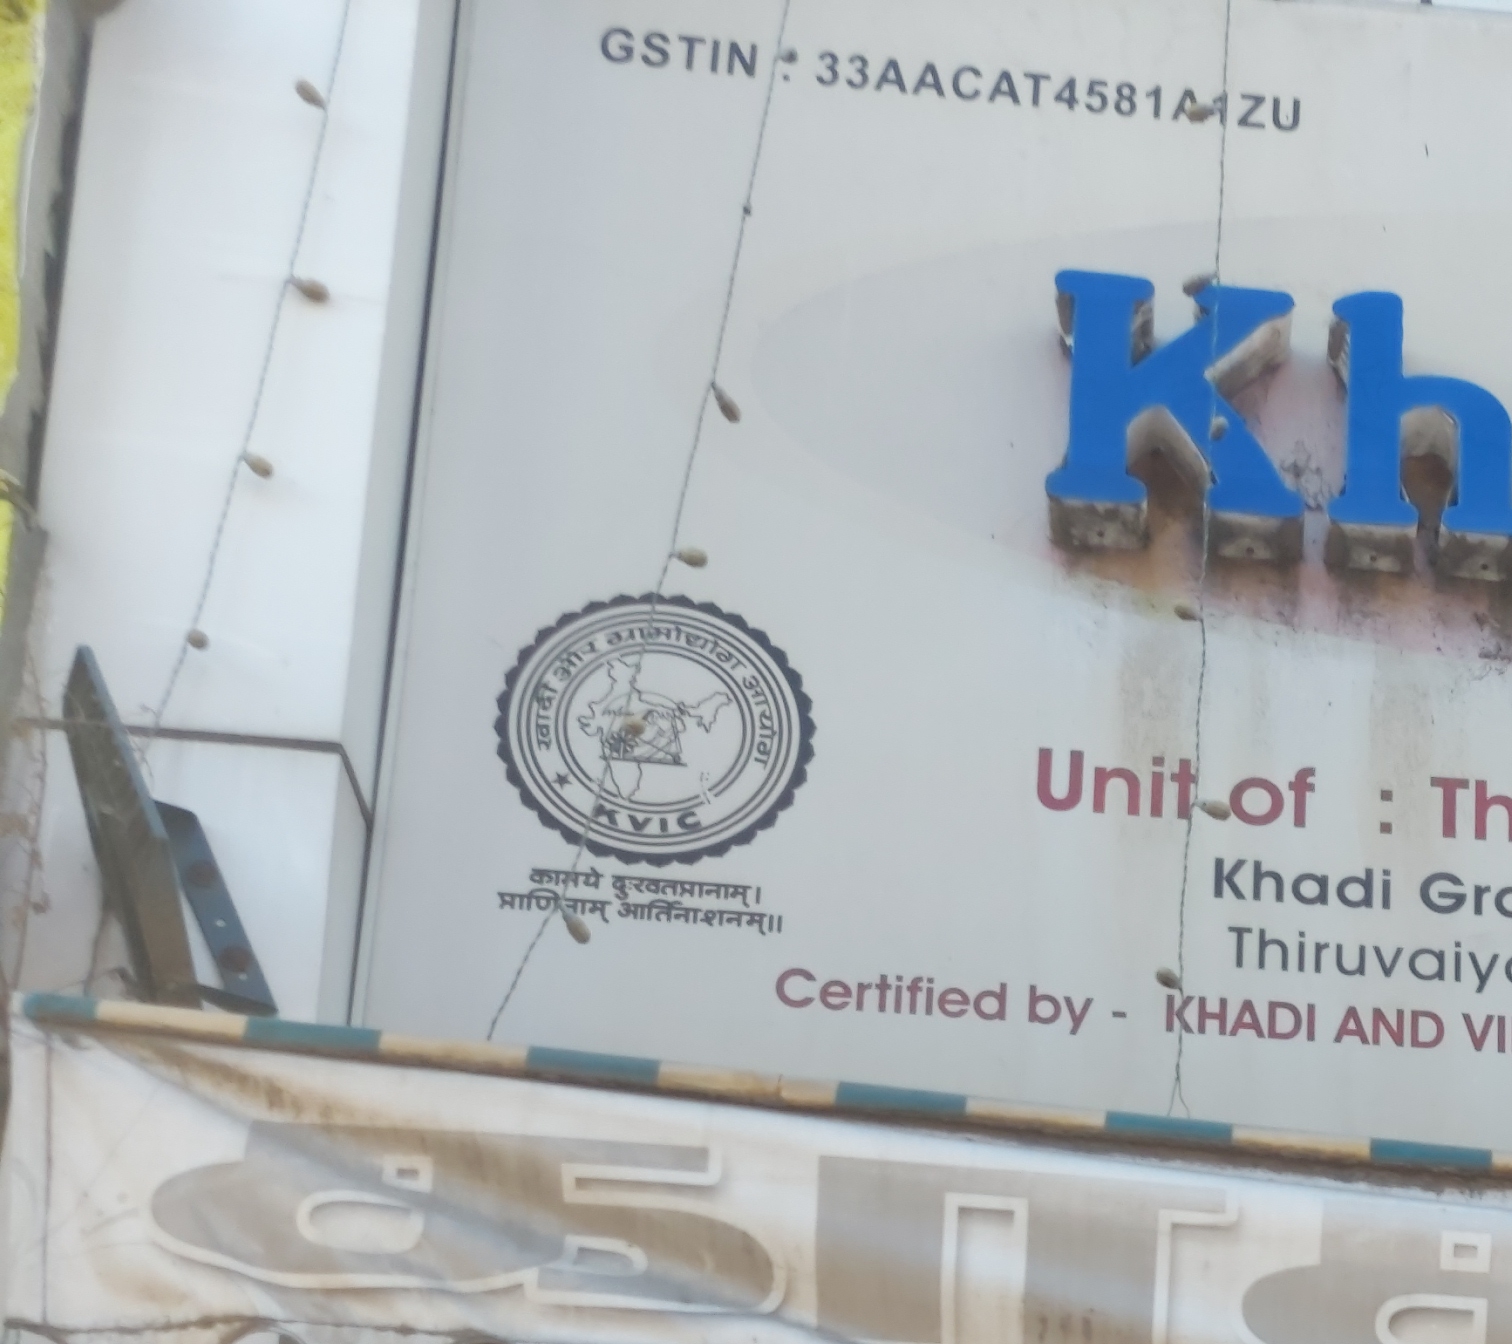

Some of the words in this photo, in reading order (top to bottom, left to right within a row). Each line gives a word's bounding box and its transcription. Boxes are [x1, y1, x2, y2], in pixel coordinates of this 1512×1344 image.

[600, 26, 758, 77] GSTIN
[1036, 746, 1197, 820] Unit
[1228, 766, 1316, 827] of
[1212, 857, 1392, 911] Khadi
[774, 966, 1007, 1023] Certified
[1025, 981, 1094, 1036] by
[1165, 992, 1316, 1044] KHADI
[1333, 1006, 1444, 1050] AND
